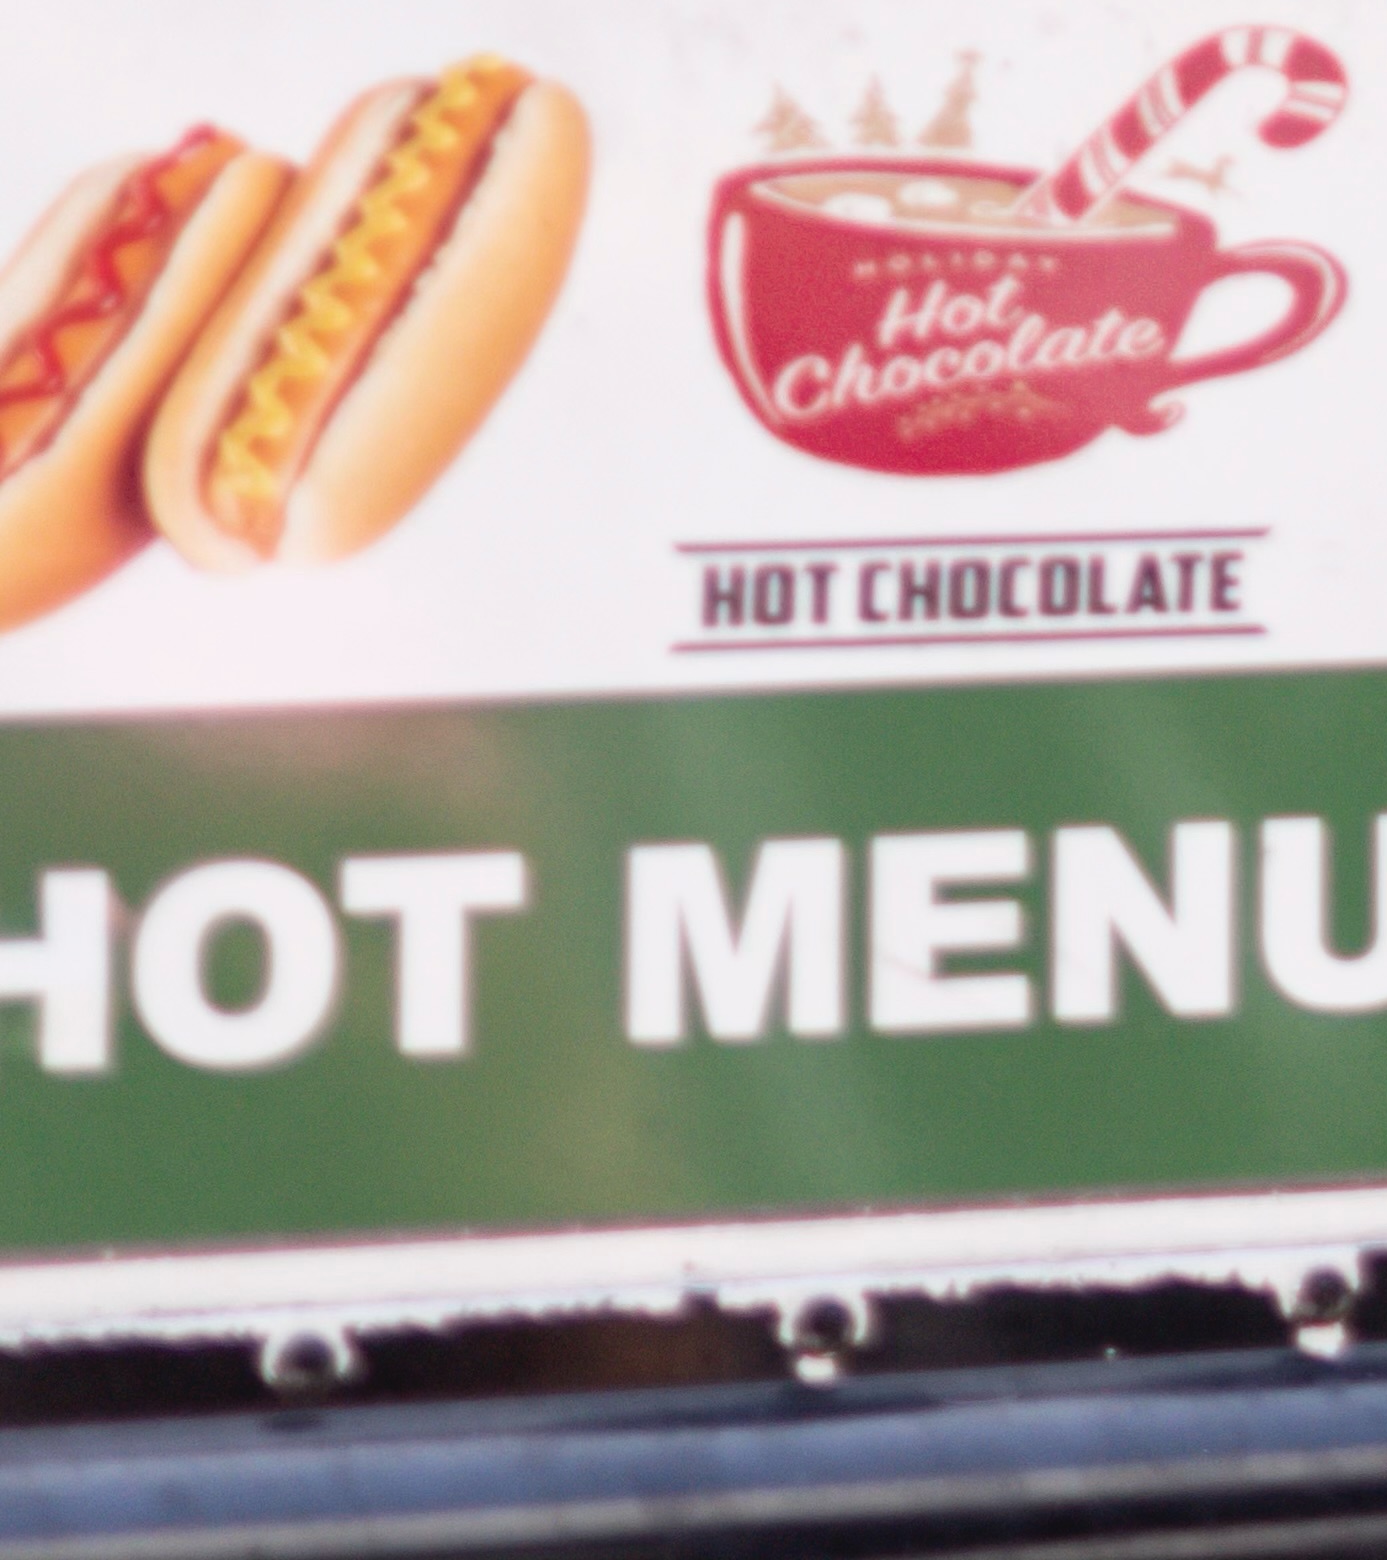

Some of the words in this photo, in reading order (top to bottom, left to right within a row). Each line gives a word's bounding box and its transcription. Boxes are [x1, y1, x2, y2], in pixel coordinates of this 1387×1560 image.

[874, 273, 1026, 348] Hot
[771, 308, 1164, 419] Chocolate
[699, 561, 840, 628] HOT
[856, 549, 1247, 624] CHOCOLATE
[0, 850, 527, 1074] HOT
